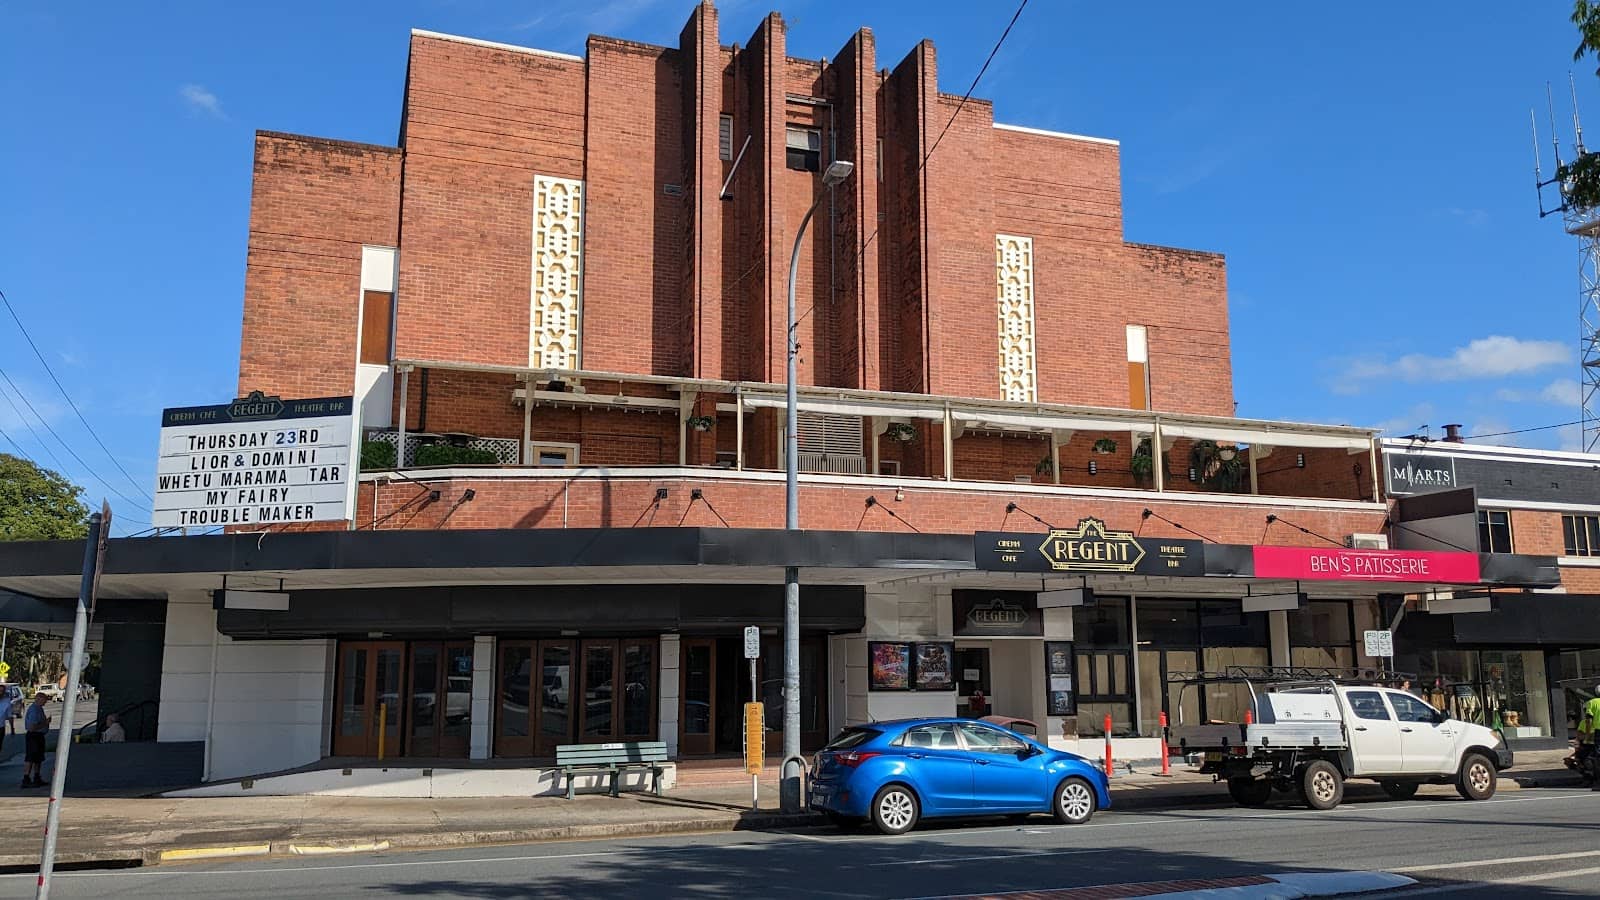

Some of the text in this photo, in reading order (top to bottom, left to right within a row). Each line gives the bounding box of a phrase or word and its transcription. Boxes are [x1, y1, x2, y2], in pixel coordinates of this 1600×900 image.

[233, 402, 276, 416] REGENT
[188, 429, 319, 450] THURSDAY 23RD
[191, 450, 316, 470] LIOR & DOMINI
[159, 467, 340, 490] WHETU MARAMA TAR
[206, 487, 289, 506] MY FAIRY
[180, 505, 314, 525] TROUBLE MAKER
[997, 540, 1021, 548] CINEMA
[1054, 540, 1130, 562] REGENT
[1160, 545, 1185, 554] THEATRE
[1311, 554, 1430, 575] BEN'S PATISSERIE
[975, 610, 1020, 622] REGENT
